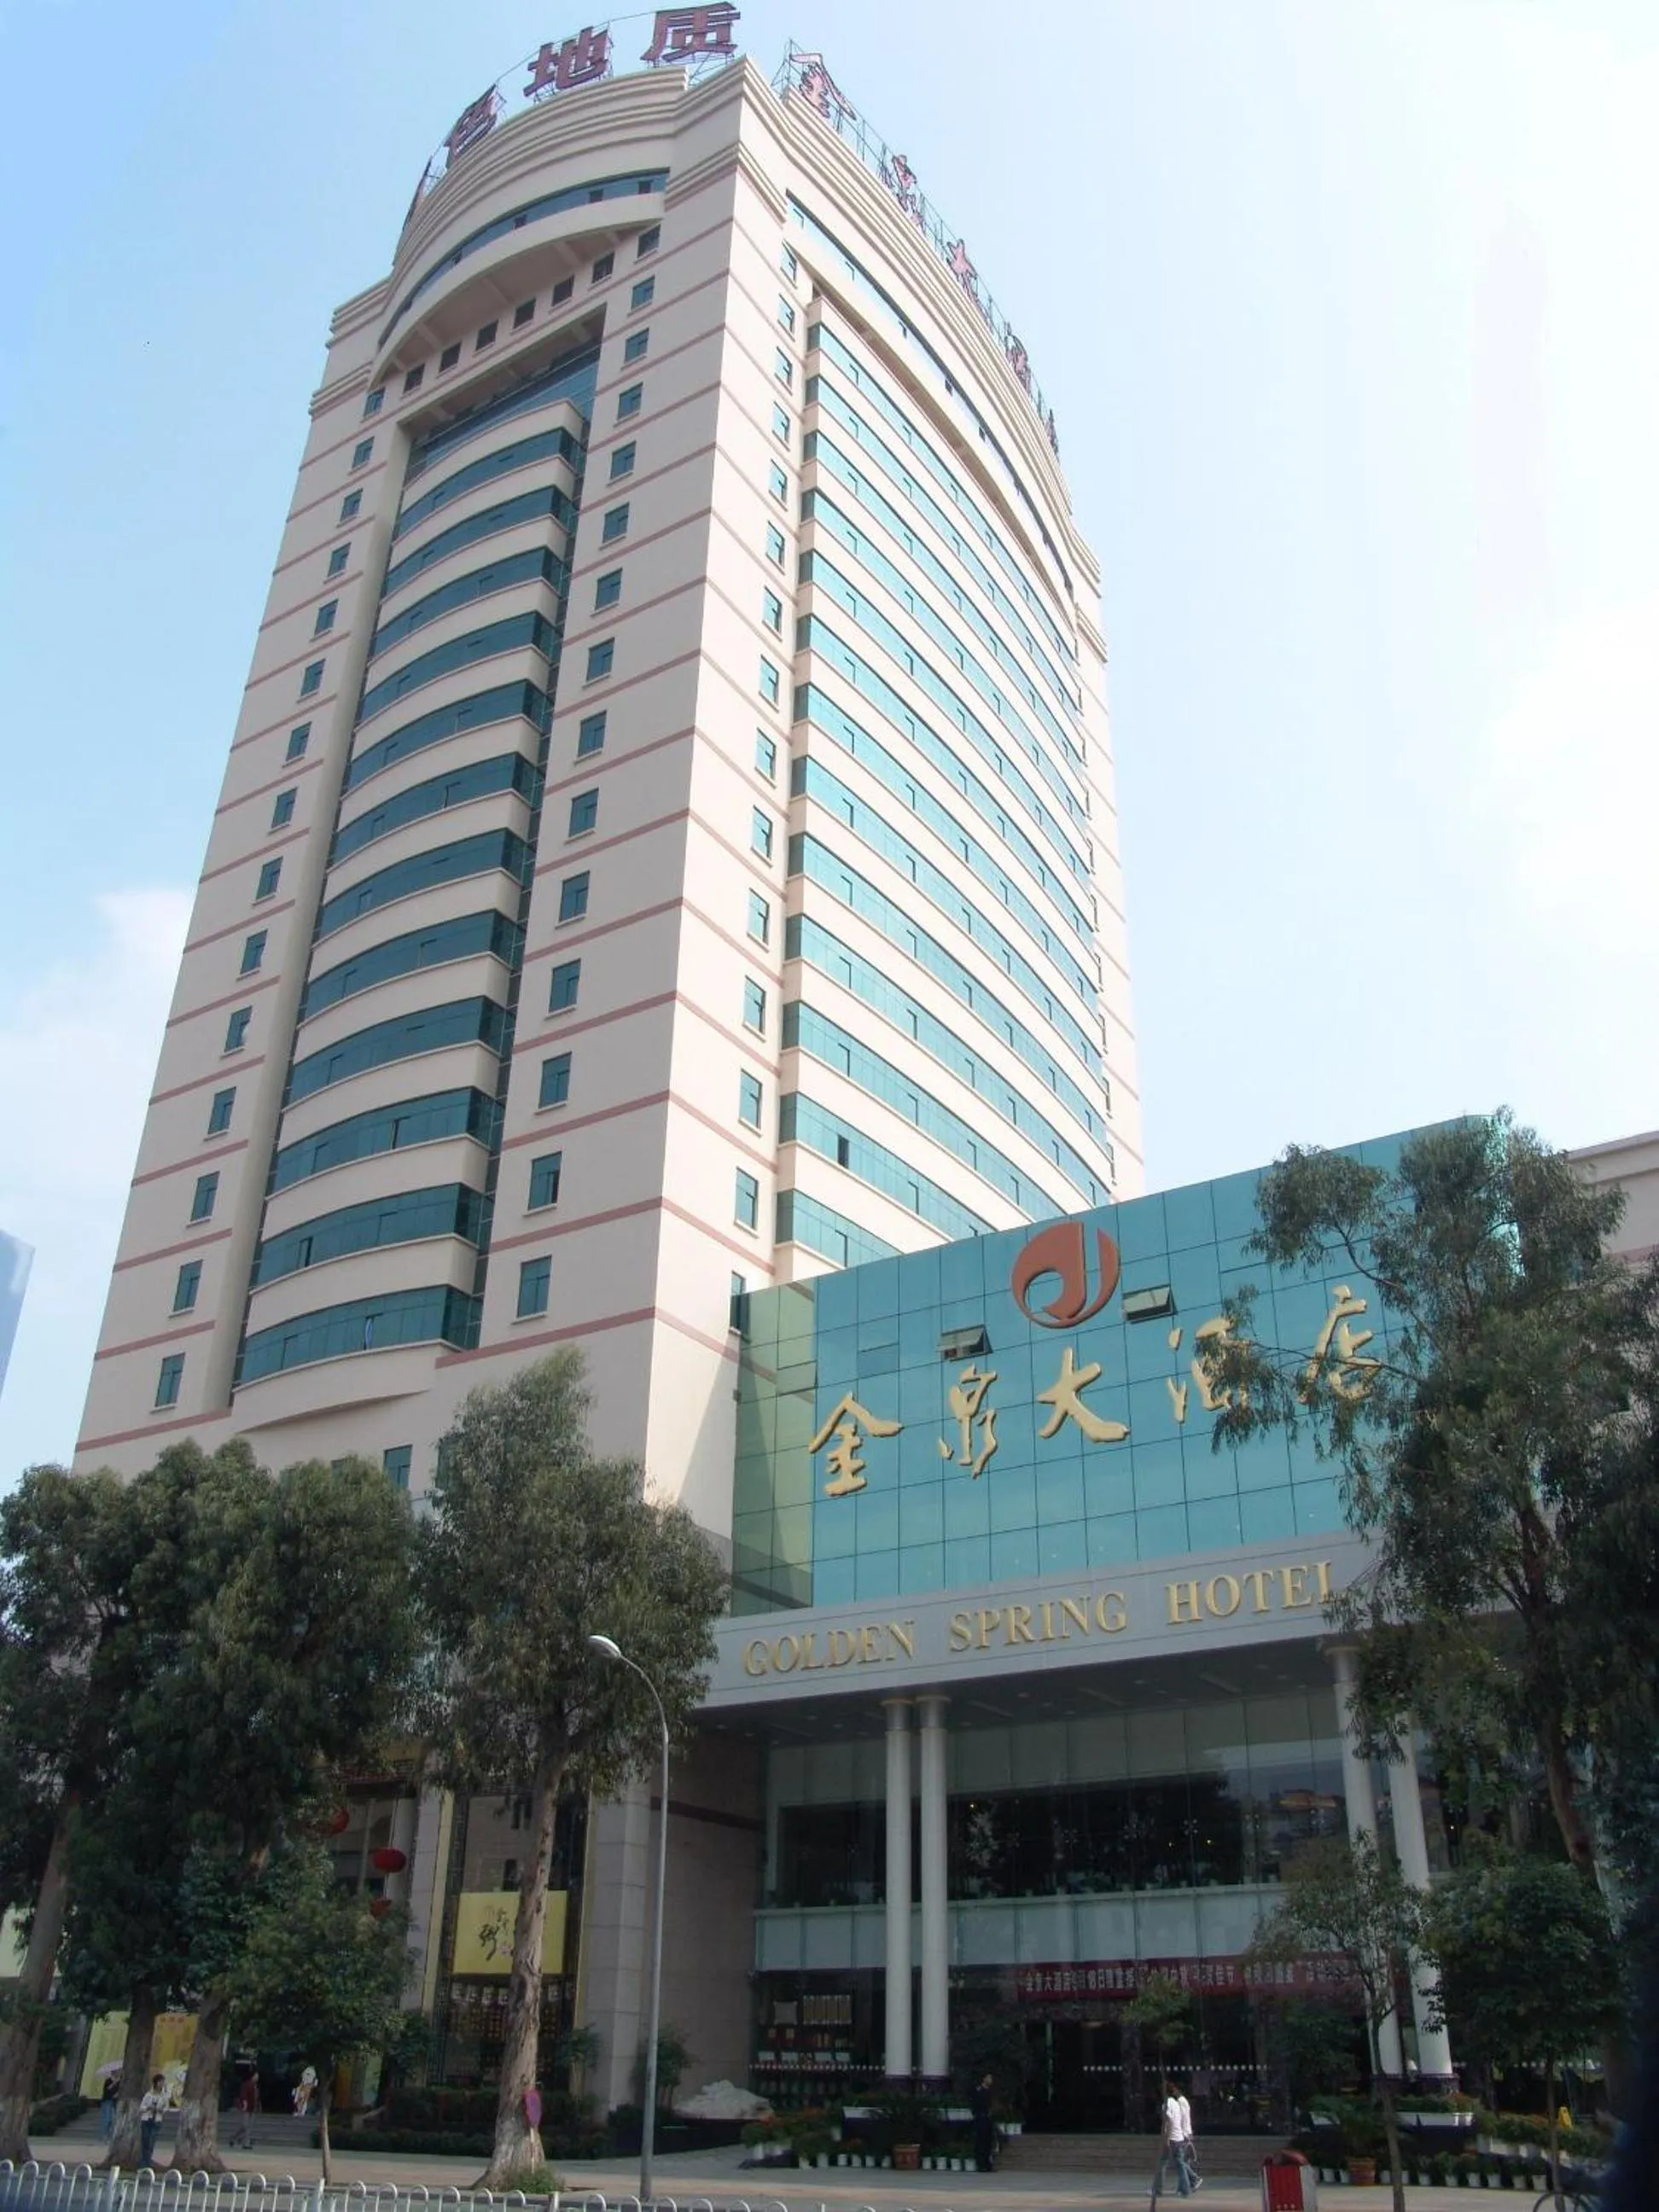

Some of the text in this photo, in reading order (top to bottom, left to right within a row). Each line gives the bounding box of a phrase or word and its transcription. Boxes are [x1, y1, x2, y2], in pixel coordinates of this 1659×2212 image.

[742, 1559, 1347, 1678] GOLDEN SPRING HOTEL
